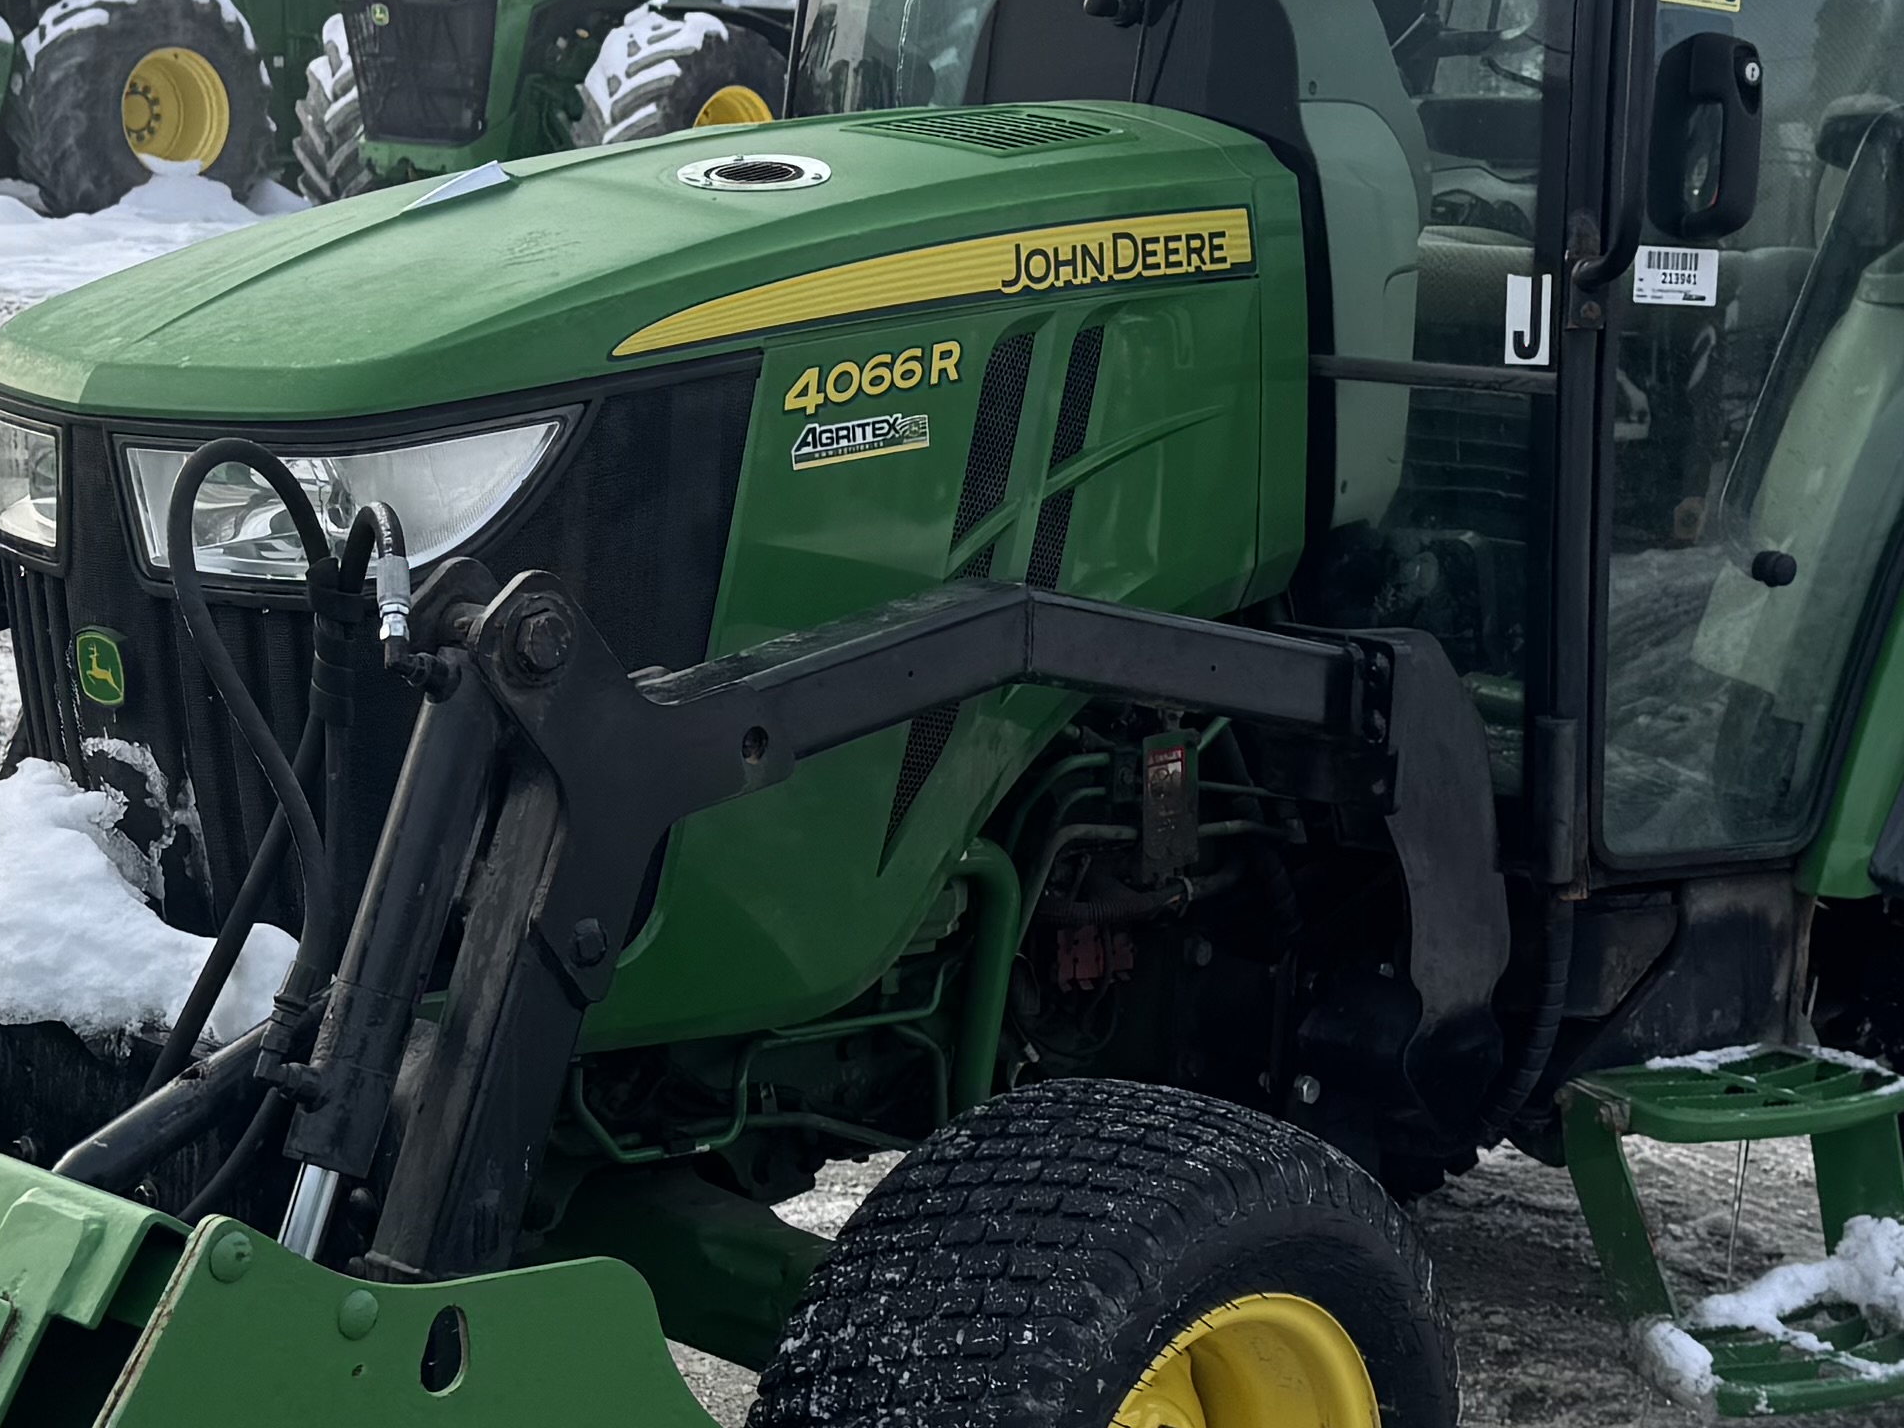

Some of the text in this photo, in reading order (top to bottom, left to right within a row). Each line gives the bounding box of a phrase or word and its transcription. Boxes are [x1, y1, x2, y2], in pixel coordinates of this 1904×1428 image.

[1001, 231, 1228, 289] JOHN DEERE
[1512, 274, 1542, 360] J
[794, 416, 901, 452] AGRITEX
